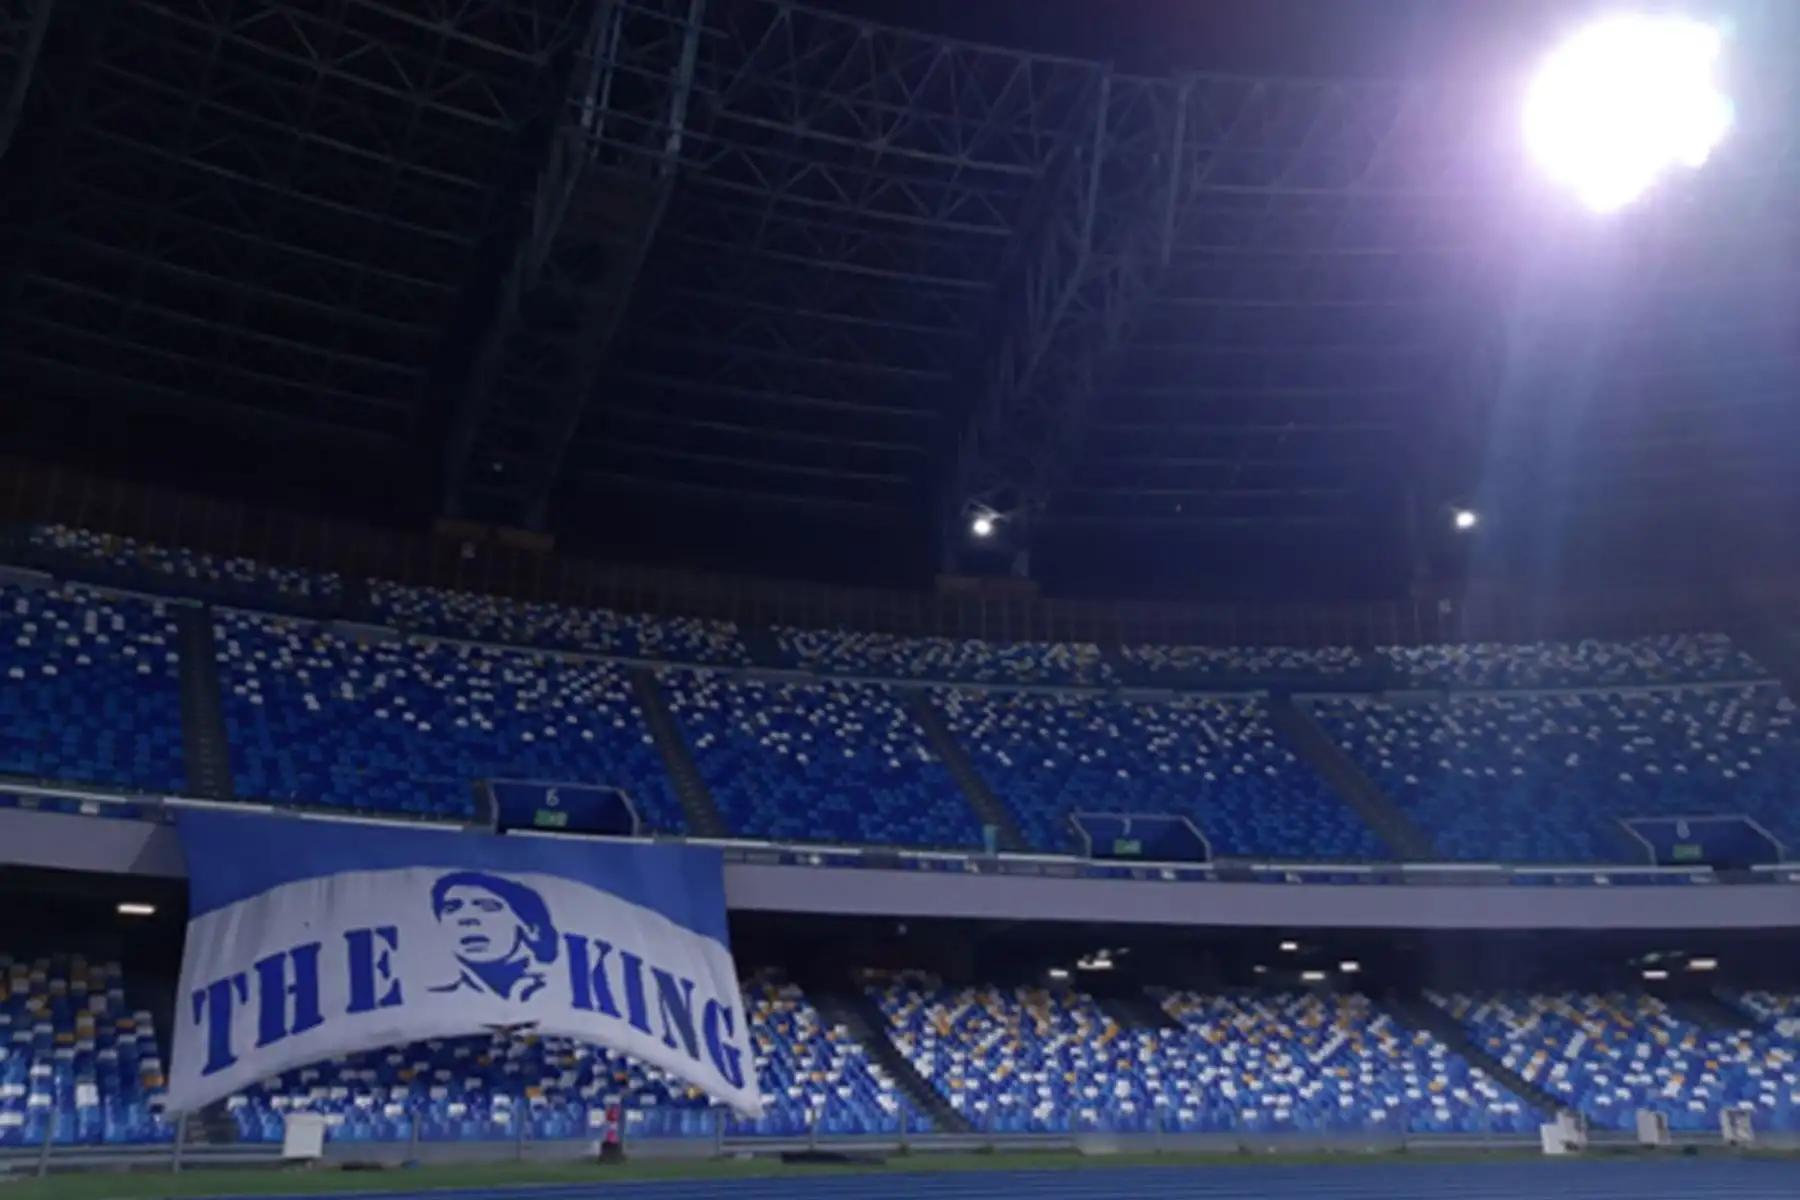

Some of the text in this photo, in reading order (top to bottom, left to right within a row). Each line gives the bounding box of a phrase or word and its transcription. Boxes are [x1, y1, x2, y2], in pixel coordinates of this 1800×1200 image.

[545, 788, 560, 807] 6
[191, 925, 745, 1089] THE KING
